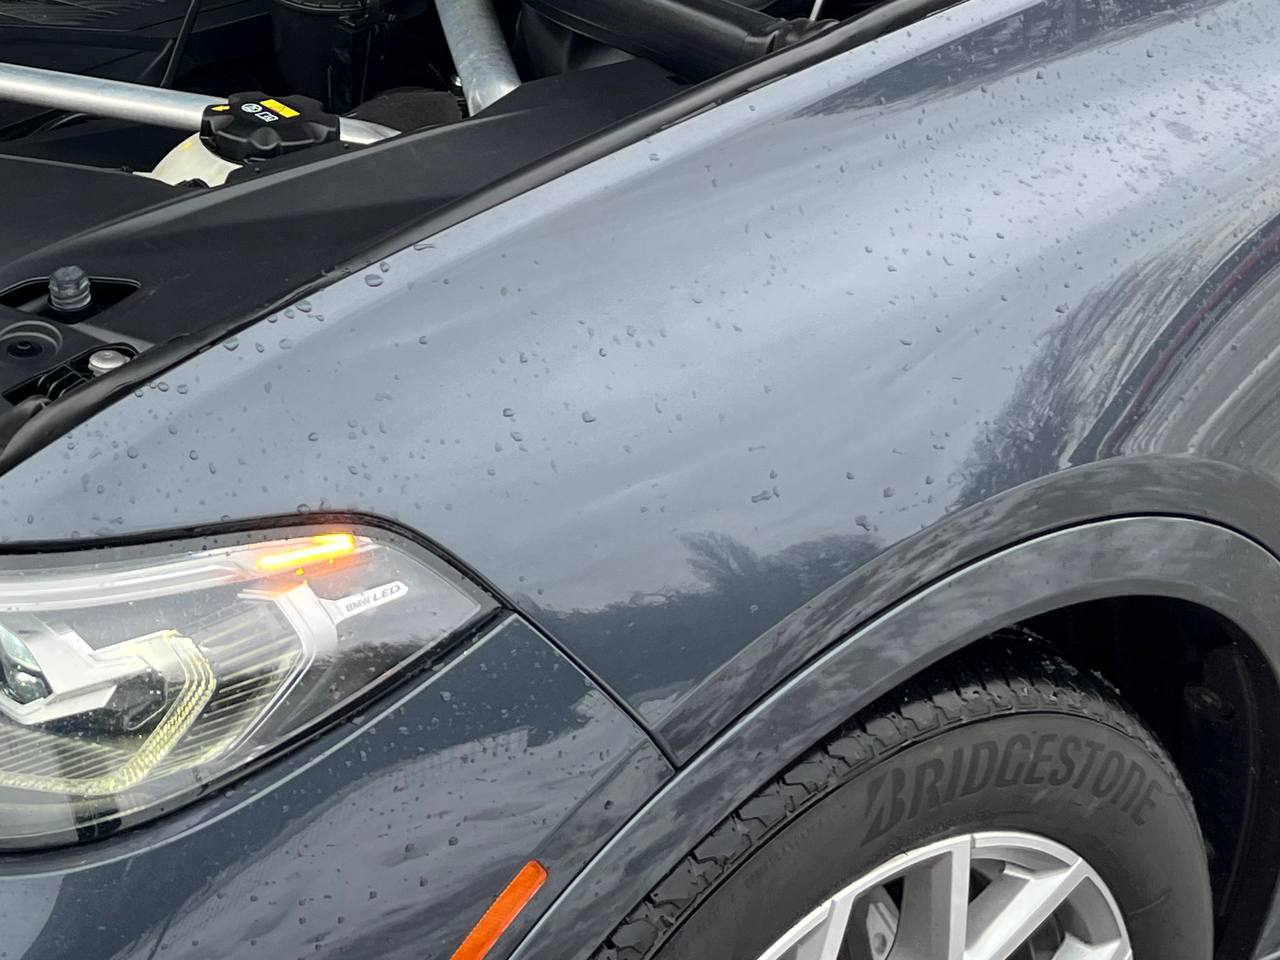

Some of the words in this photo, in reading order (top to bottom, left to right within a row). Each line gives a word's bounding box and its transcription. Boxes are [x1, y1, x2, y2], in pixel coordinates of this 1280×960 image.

[346, 596, 370, 612] BMW
[373, 585, 401, 601] LED
[860, 733, 1163, 847] BRIDGESTONE
